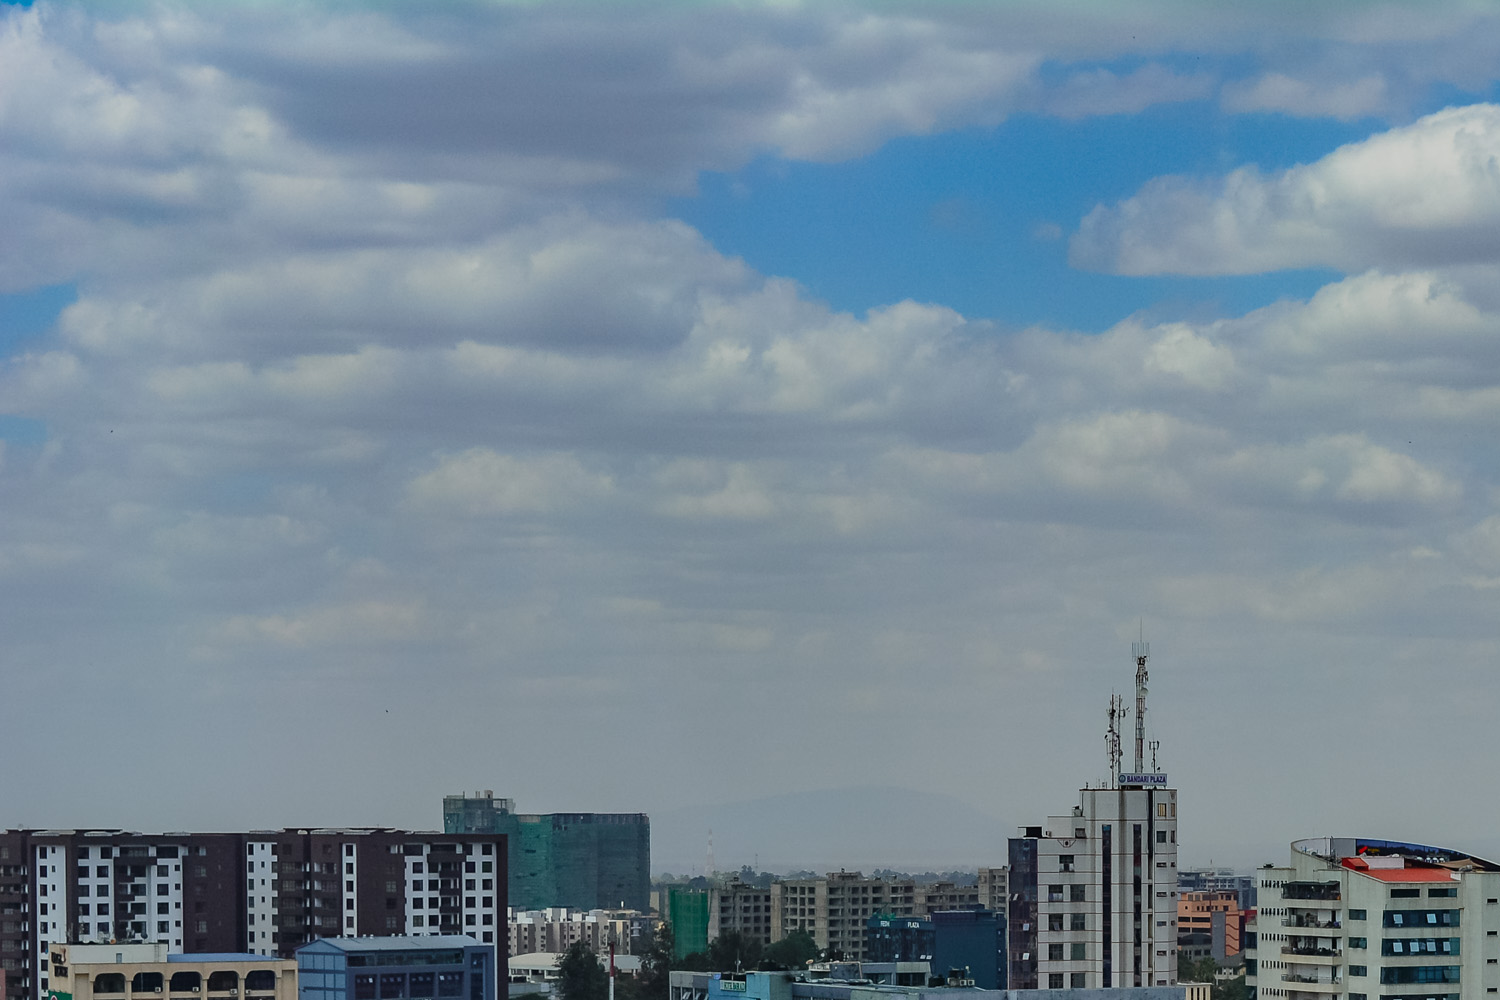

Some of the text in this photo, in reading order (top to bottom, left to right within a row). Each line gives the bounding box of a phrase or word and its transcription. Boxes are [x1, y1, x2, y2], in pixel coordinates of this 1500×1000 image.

[1127, 775, 1167, 783] BANDARI PLAZA
[907, 921, 920, 929] PLAZA
